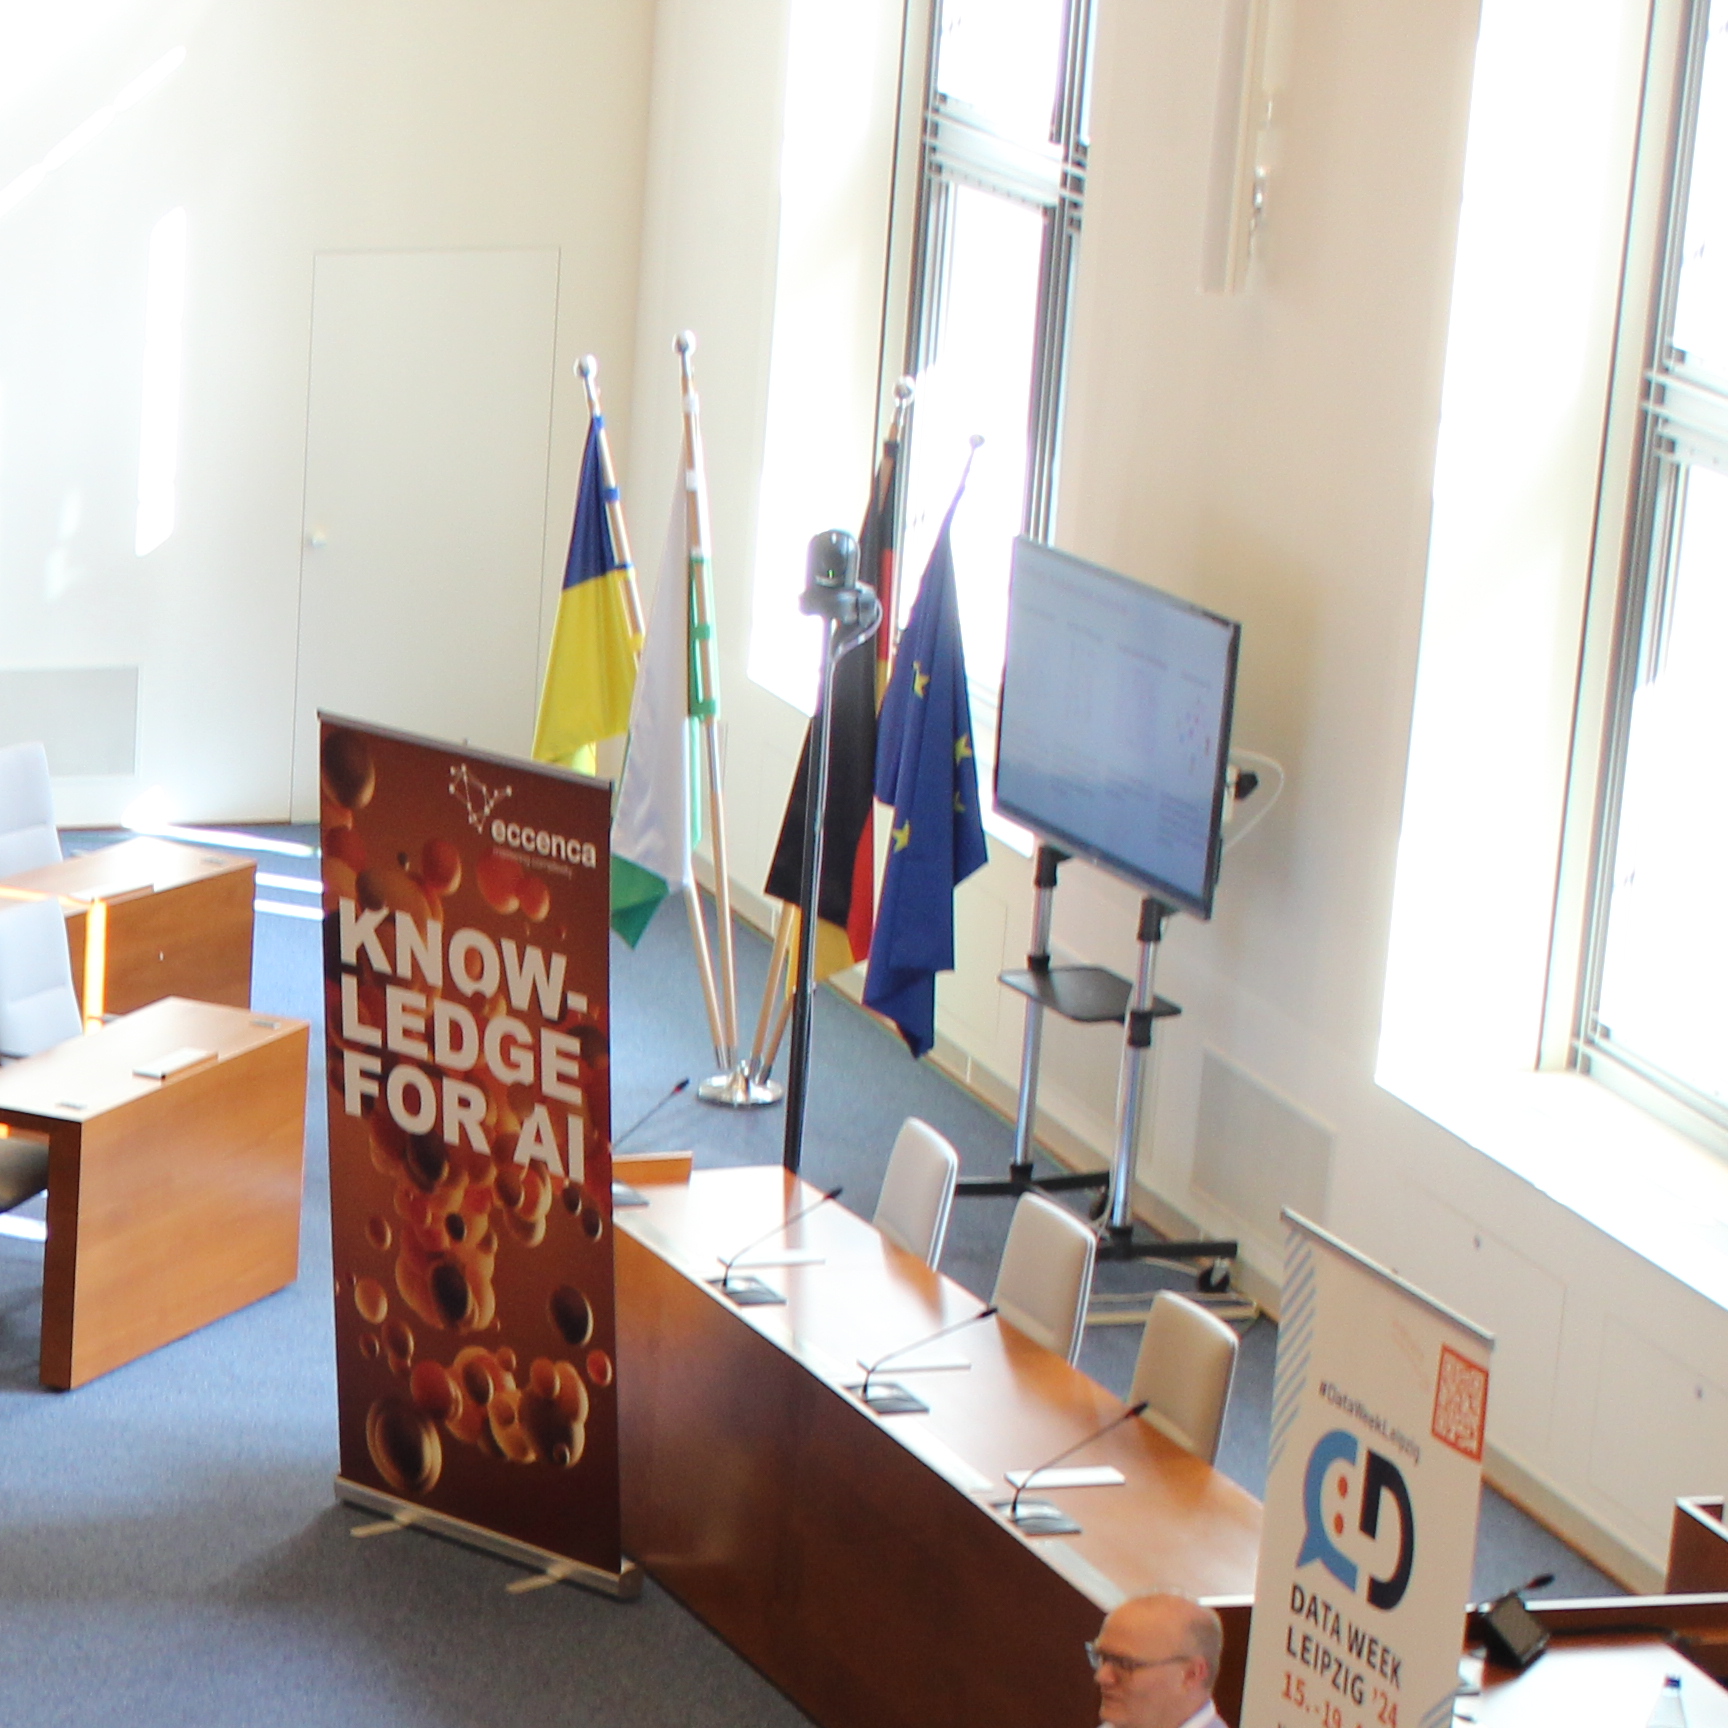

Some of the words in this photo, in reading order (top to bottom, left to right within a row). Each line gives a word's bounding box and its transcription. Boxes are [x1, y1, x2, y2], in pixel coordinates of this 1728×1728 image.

[491, 818, 597, 869] eccenca
[339, 896, 587, 1022] KNOW-
[341, 973, 582, 1106] LEDGE
[343, 1051, 490, 1156] FOR
[512, 1102, 585, 1184] AI
[1285, 1624, 1365, 1706] LEIPZIG
[1290, 1581, 1341, 1645] DATA
[1348, 1620, 1403, 1690] WEEK
